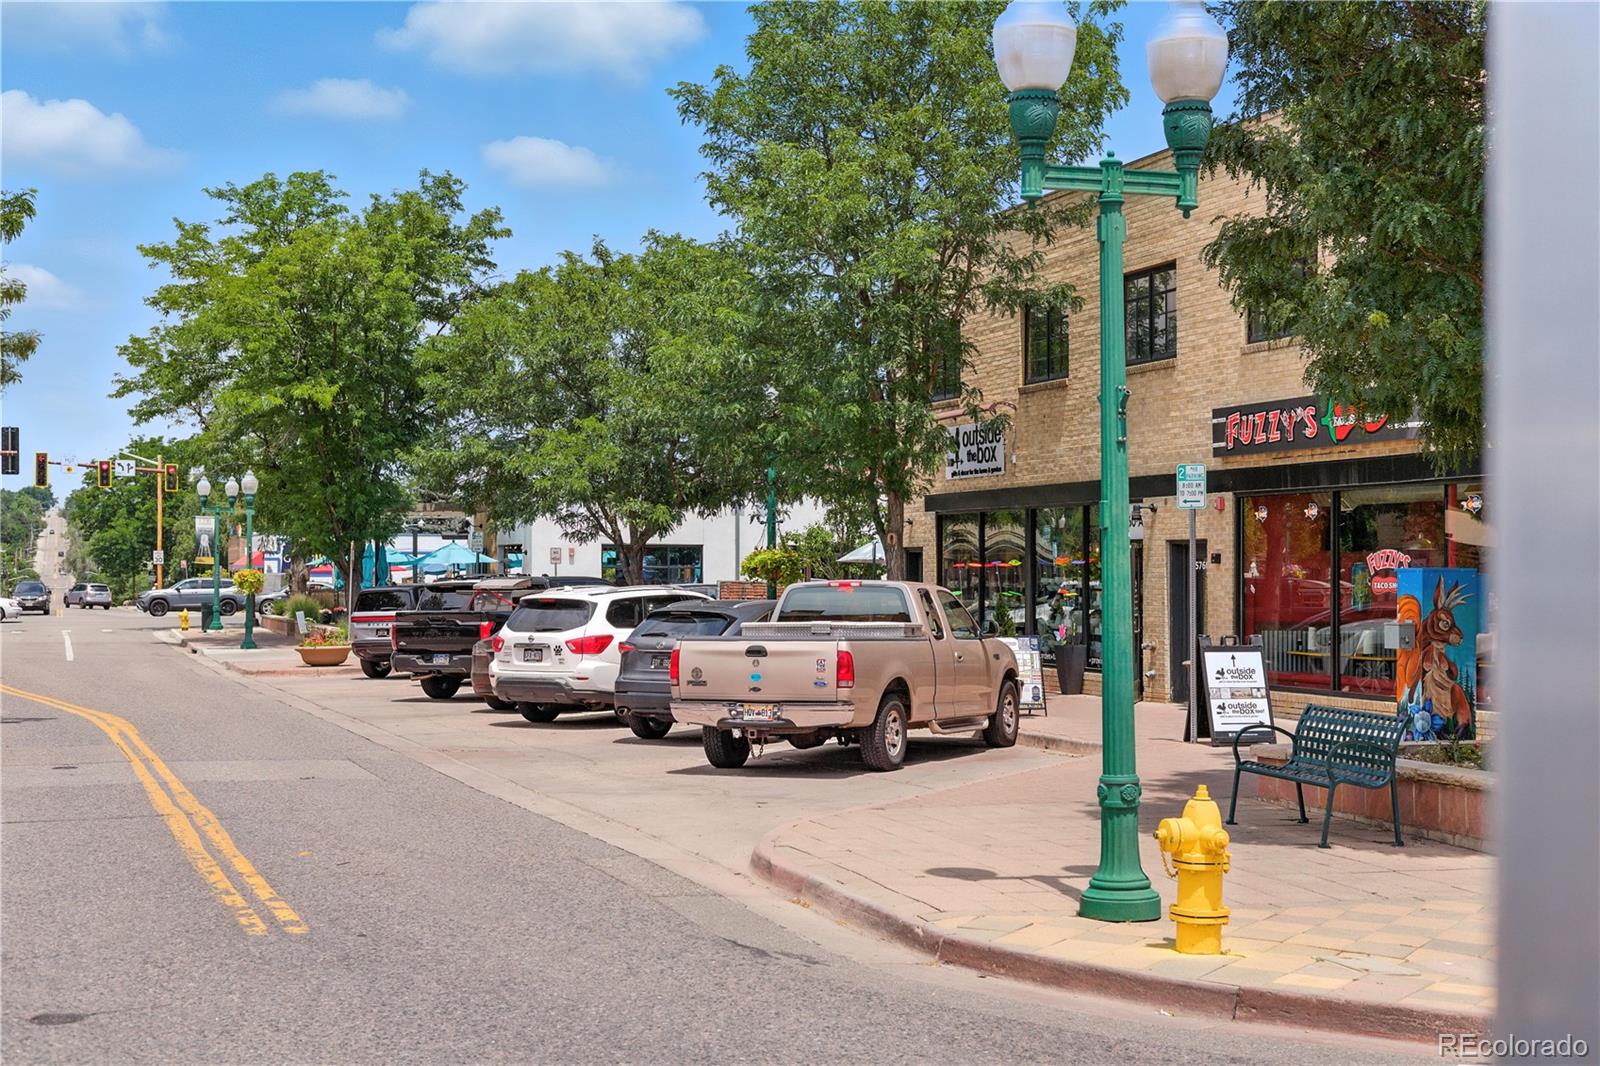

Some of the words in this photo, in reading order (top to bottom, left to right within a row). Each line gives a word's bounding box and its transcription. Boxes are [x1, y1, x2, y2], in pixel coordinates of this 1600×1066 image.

[962, 424, 1001, 447] outside
[1226, 405, 1318, 450] FUZZY'S
[967, 449, 977, 462] the
[977, 444, 997, 464] box
[1178, 466, 1186, 479] 2
[1366, 549, 1412, 576] FUZZY'S
[1374, 582, 1389, 590] TACO
[1226, 667, 1256, 676] outside
[1228, 702, 1257, 710] outside
